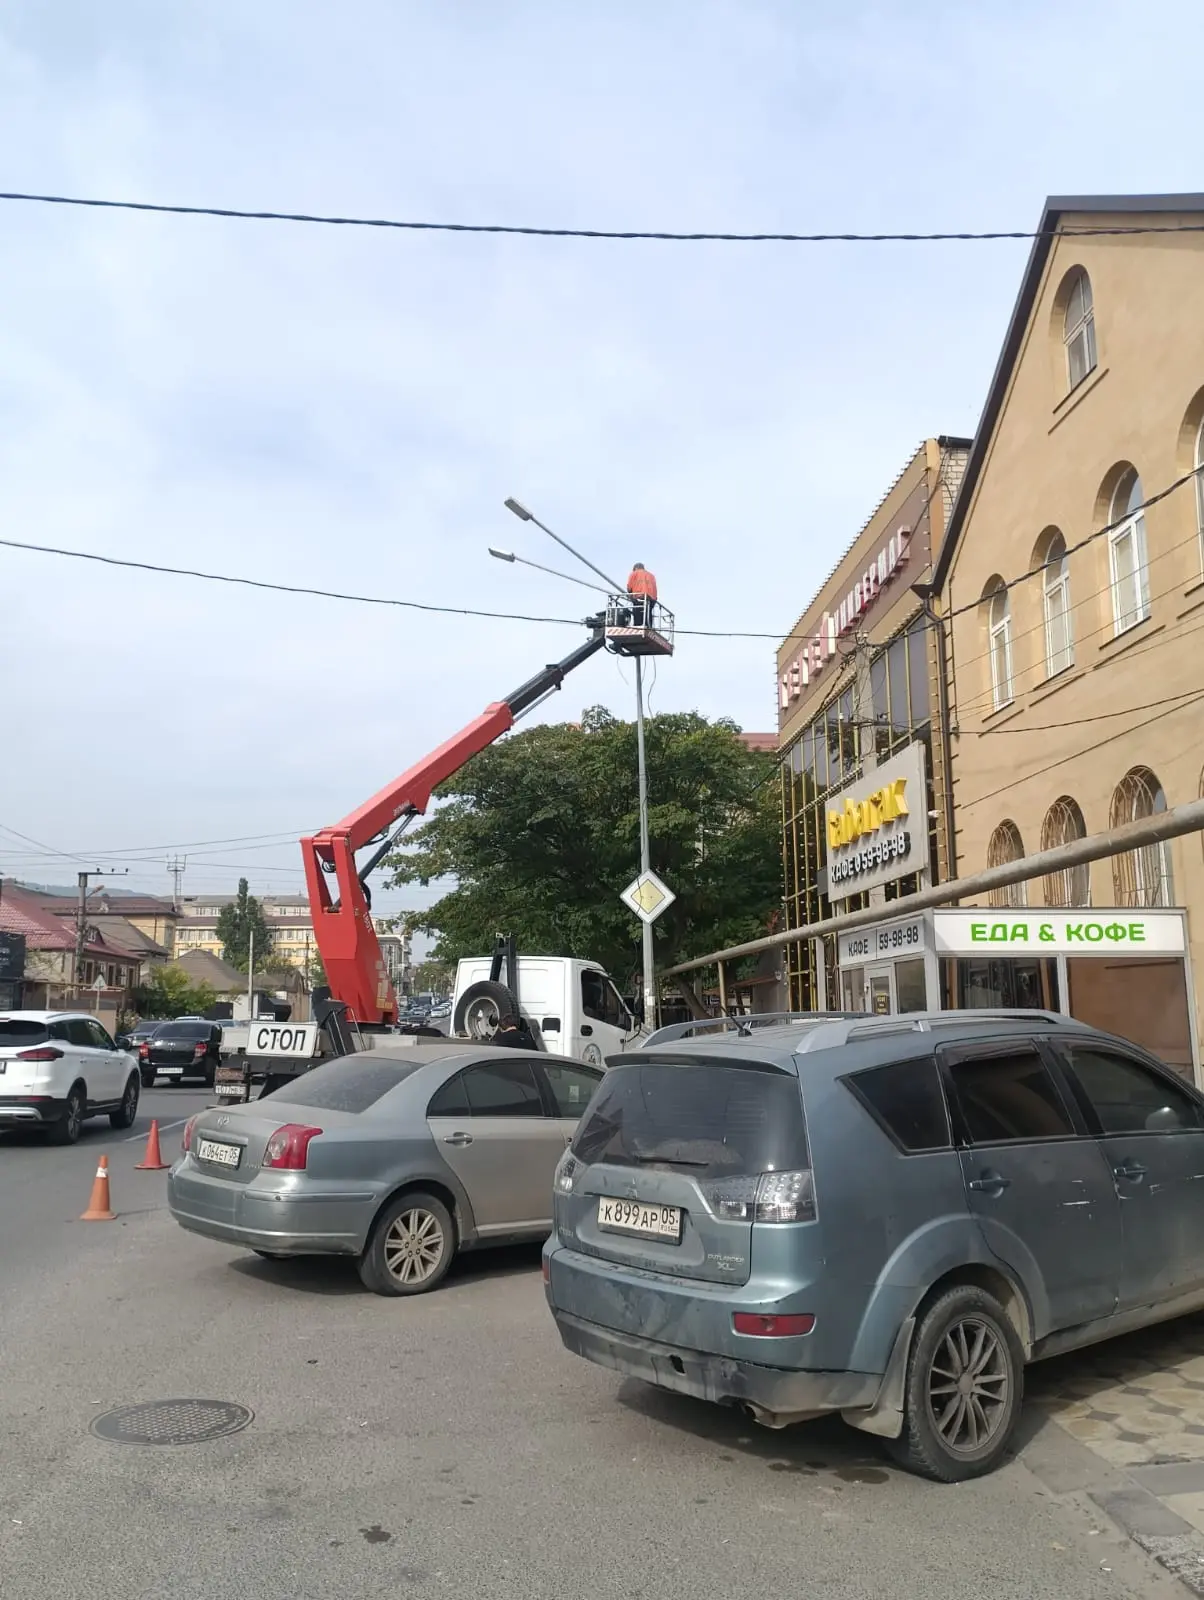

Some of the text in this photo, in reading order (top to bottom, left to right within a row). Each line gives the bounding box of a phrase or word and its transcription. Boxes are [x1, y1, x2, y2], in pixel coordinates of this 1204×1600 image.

[833, 525, 912, 638] УНИВЕРМАГ
[831, 831, 911, 883] КАФЕ 59-98-98
[848, 926, 919, 957] КАФЕ 59-98-98
[971, 922, 1146, 942] ЕДА & КОФЕ
[257, 1027, 307, 1051] СТОП
